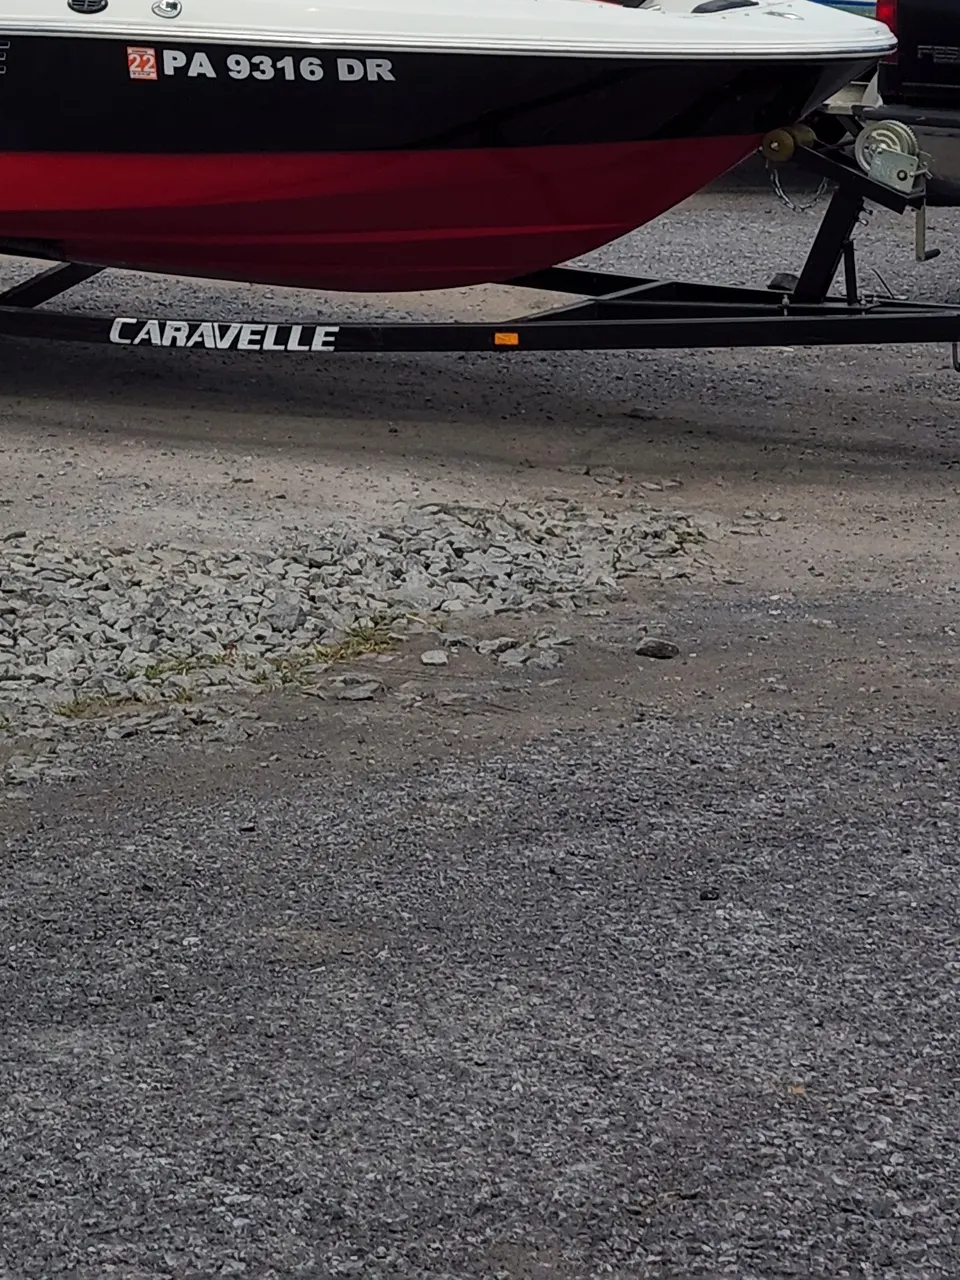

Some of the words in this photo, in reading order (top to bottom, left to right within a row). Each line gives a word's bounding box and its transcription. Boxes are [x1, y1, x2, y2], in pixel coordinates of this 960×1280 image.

[129, 53, 156, 72] 22
[163, 49, 217, 78] PA
[226, 53, 324, 81] 9316
[336, 57, 396, 81] DR
[109, 317, 340, 352] CARAVELLE
